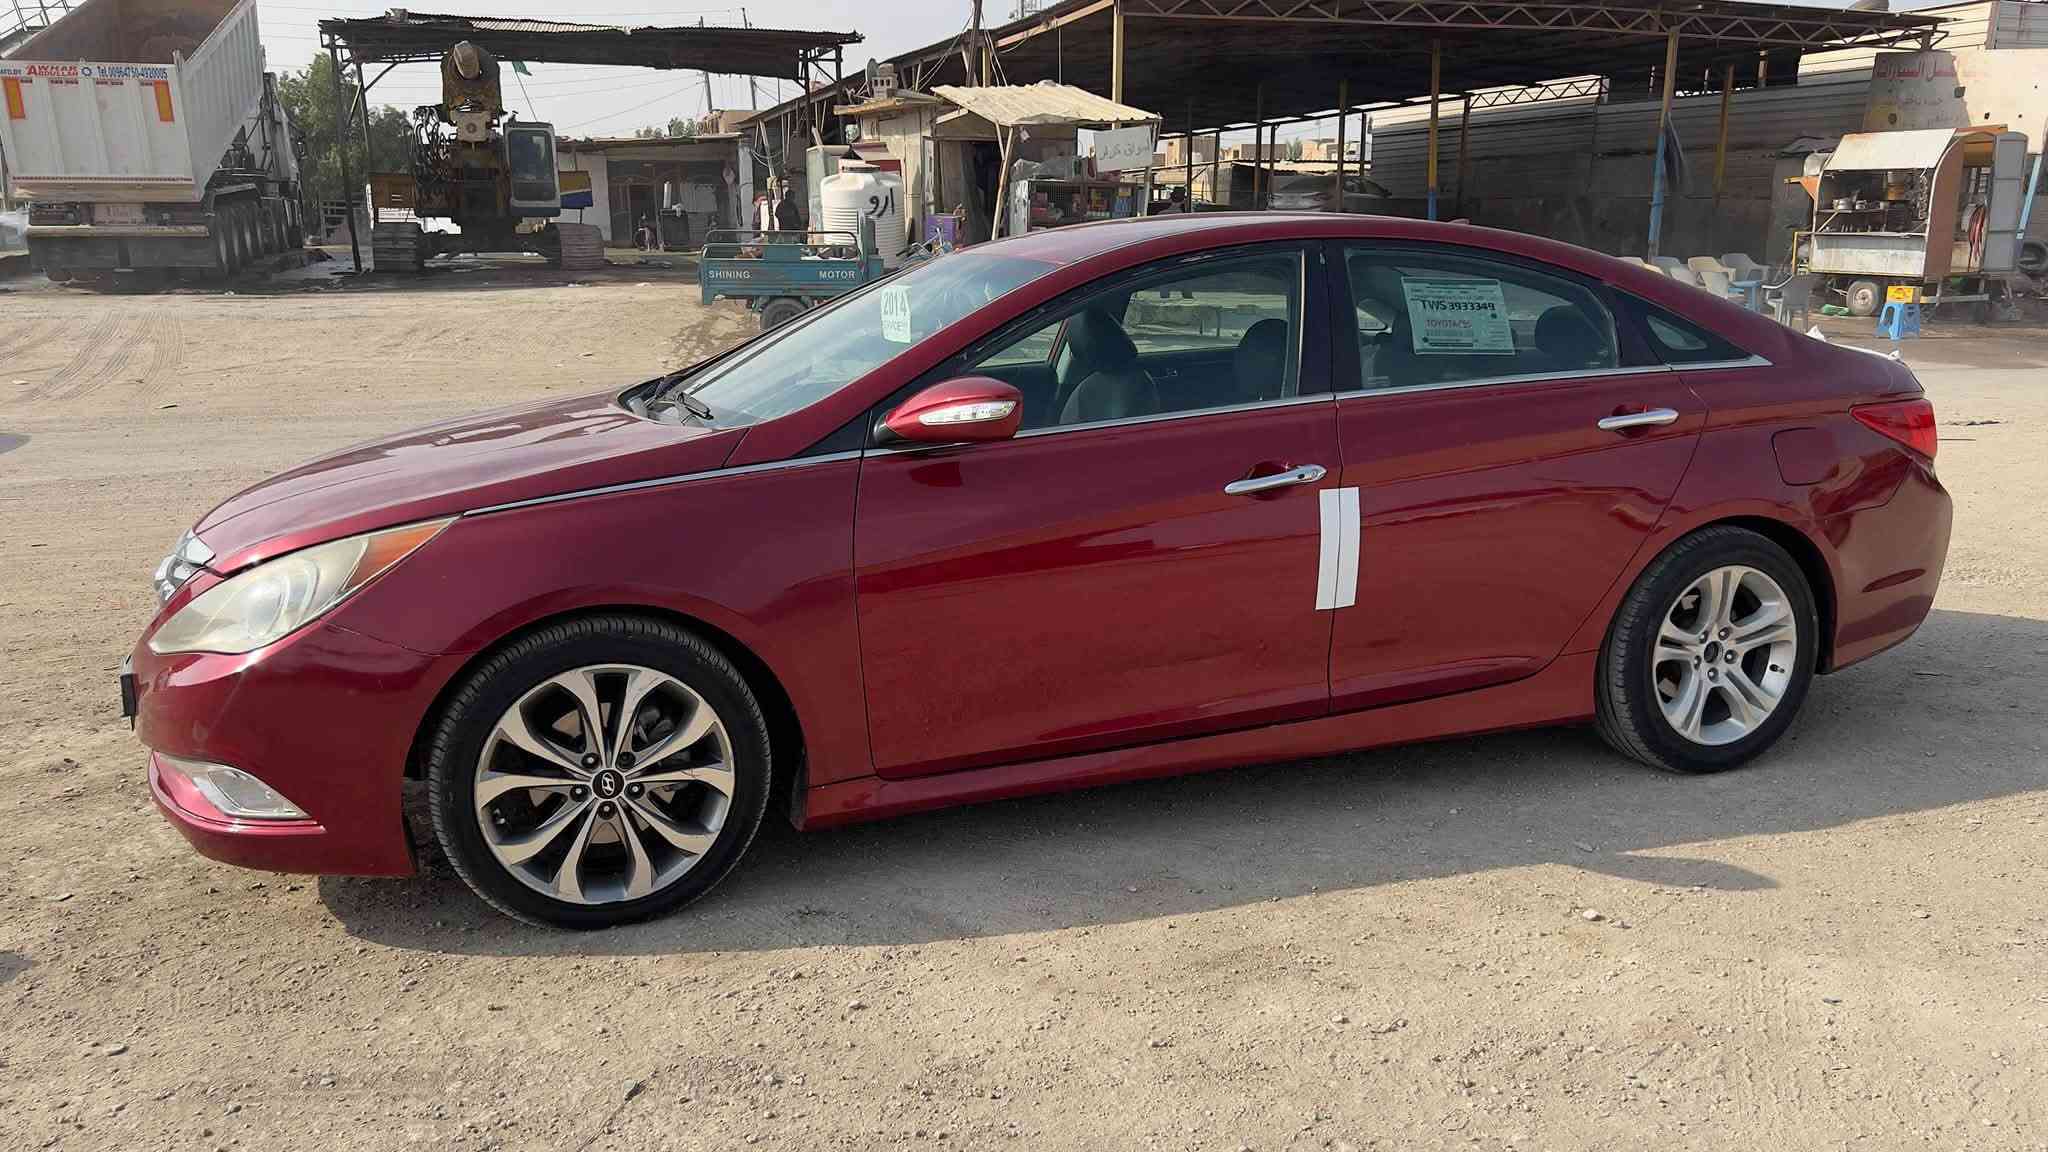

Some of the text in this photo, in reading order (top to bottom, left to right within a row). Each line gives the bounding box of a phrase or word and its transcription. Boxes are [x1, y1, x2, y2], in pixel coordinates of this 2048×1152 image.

[708, 270, 856, 279] SHINING MOTOR
[882, 290, 909, 317] 2014
